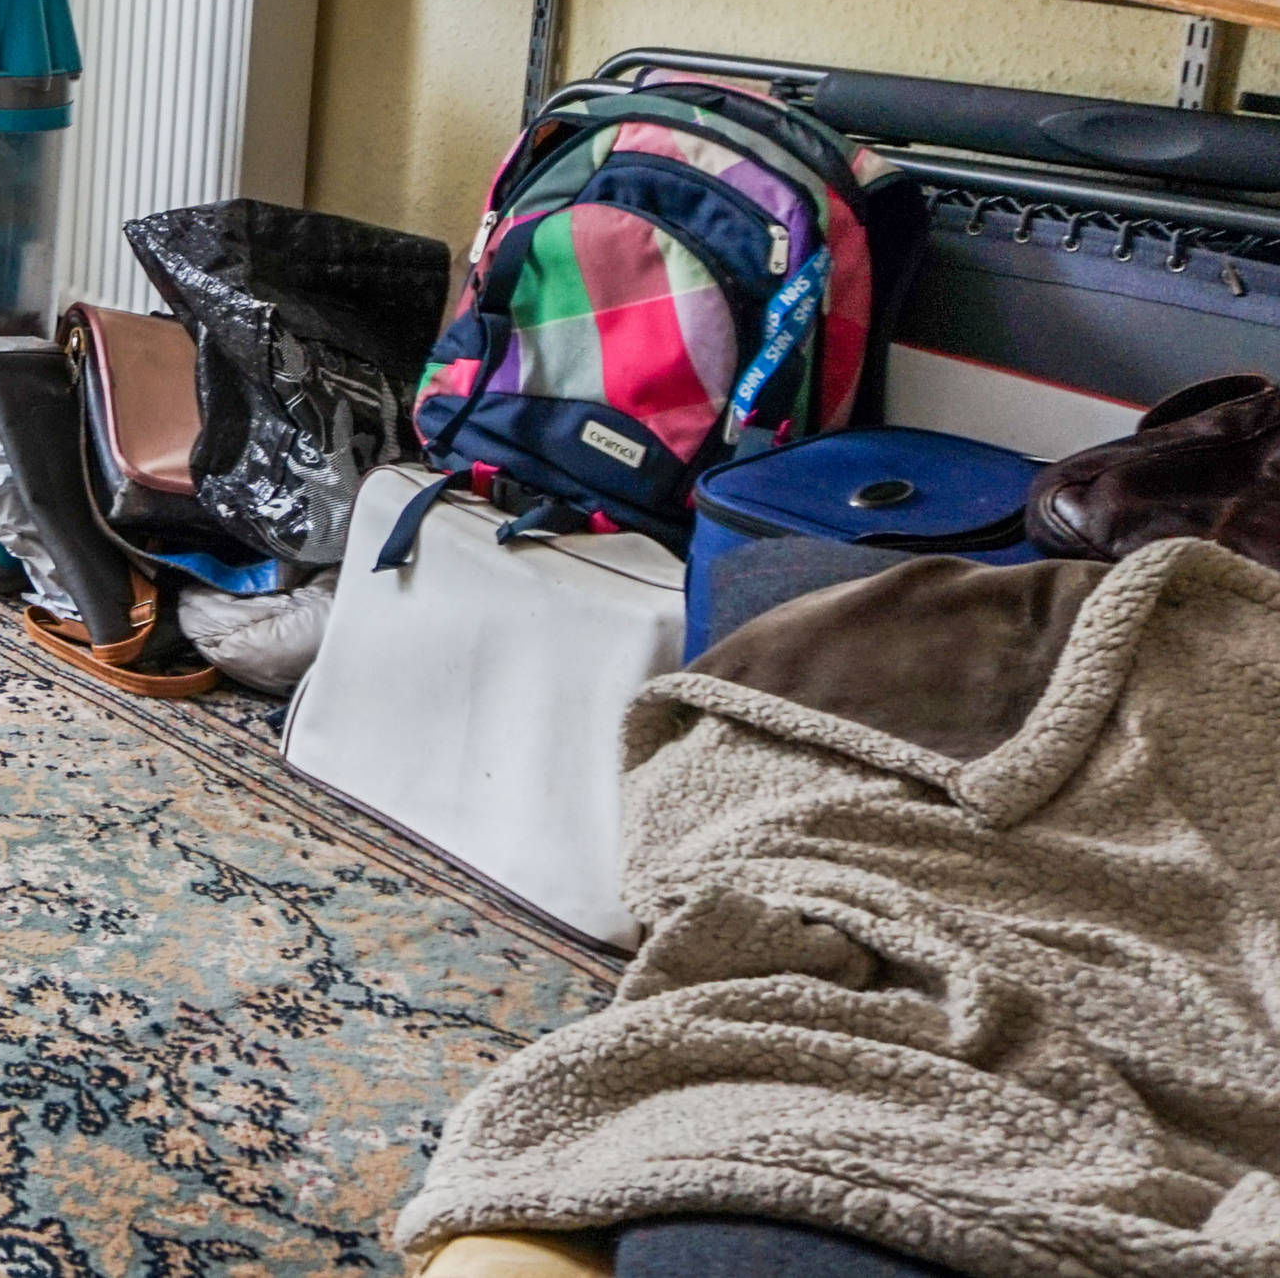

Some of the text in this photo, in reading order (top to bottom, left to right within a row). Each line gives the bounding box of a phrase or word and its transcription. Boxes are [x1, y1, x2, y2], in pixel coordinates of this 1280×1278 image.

[779, 275, 811, 307] NHS
[765, 329, 794, 363] NHS
[738, 366, 766, 403] NHS
[590, 431, 638, 461] animal
